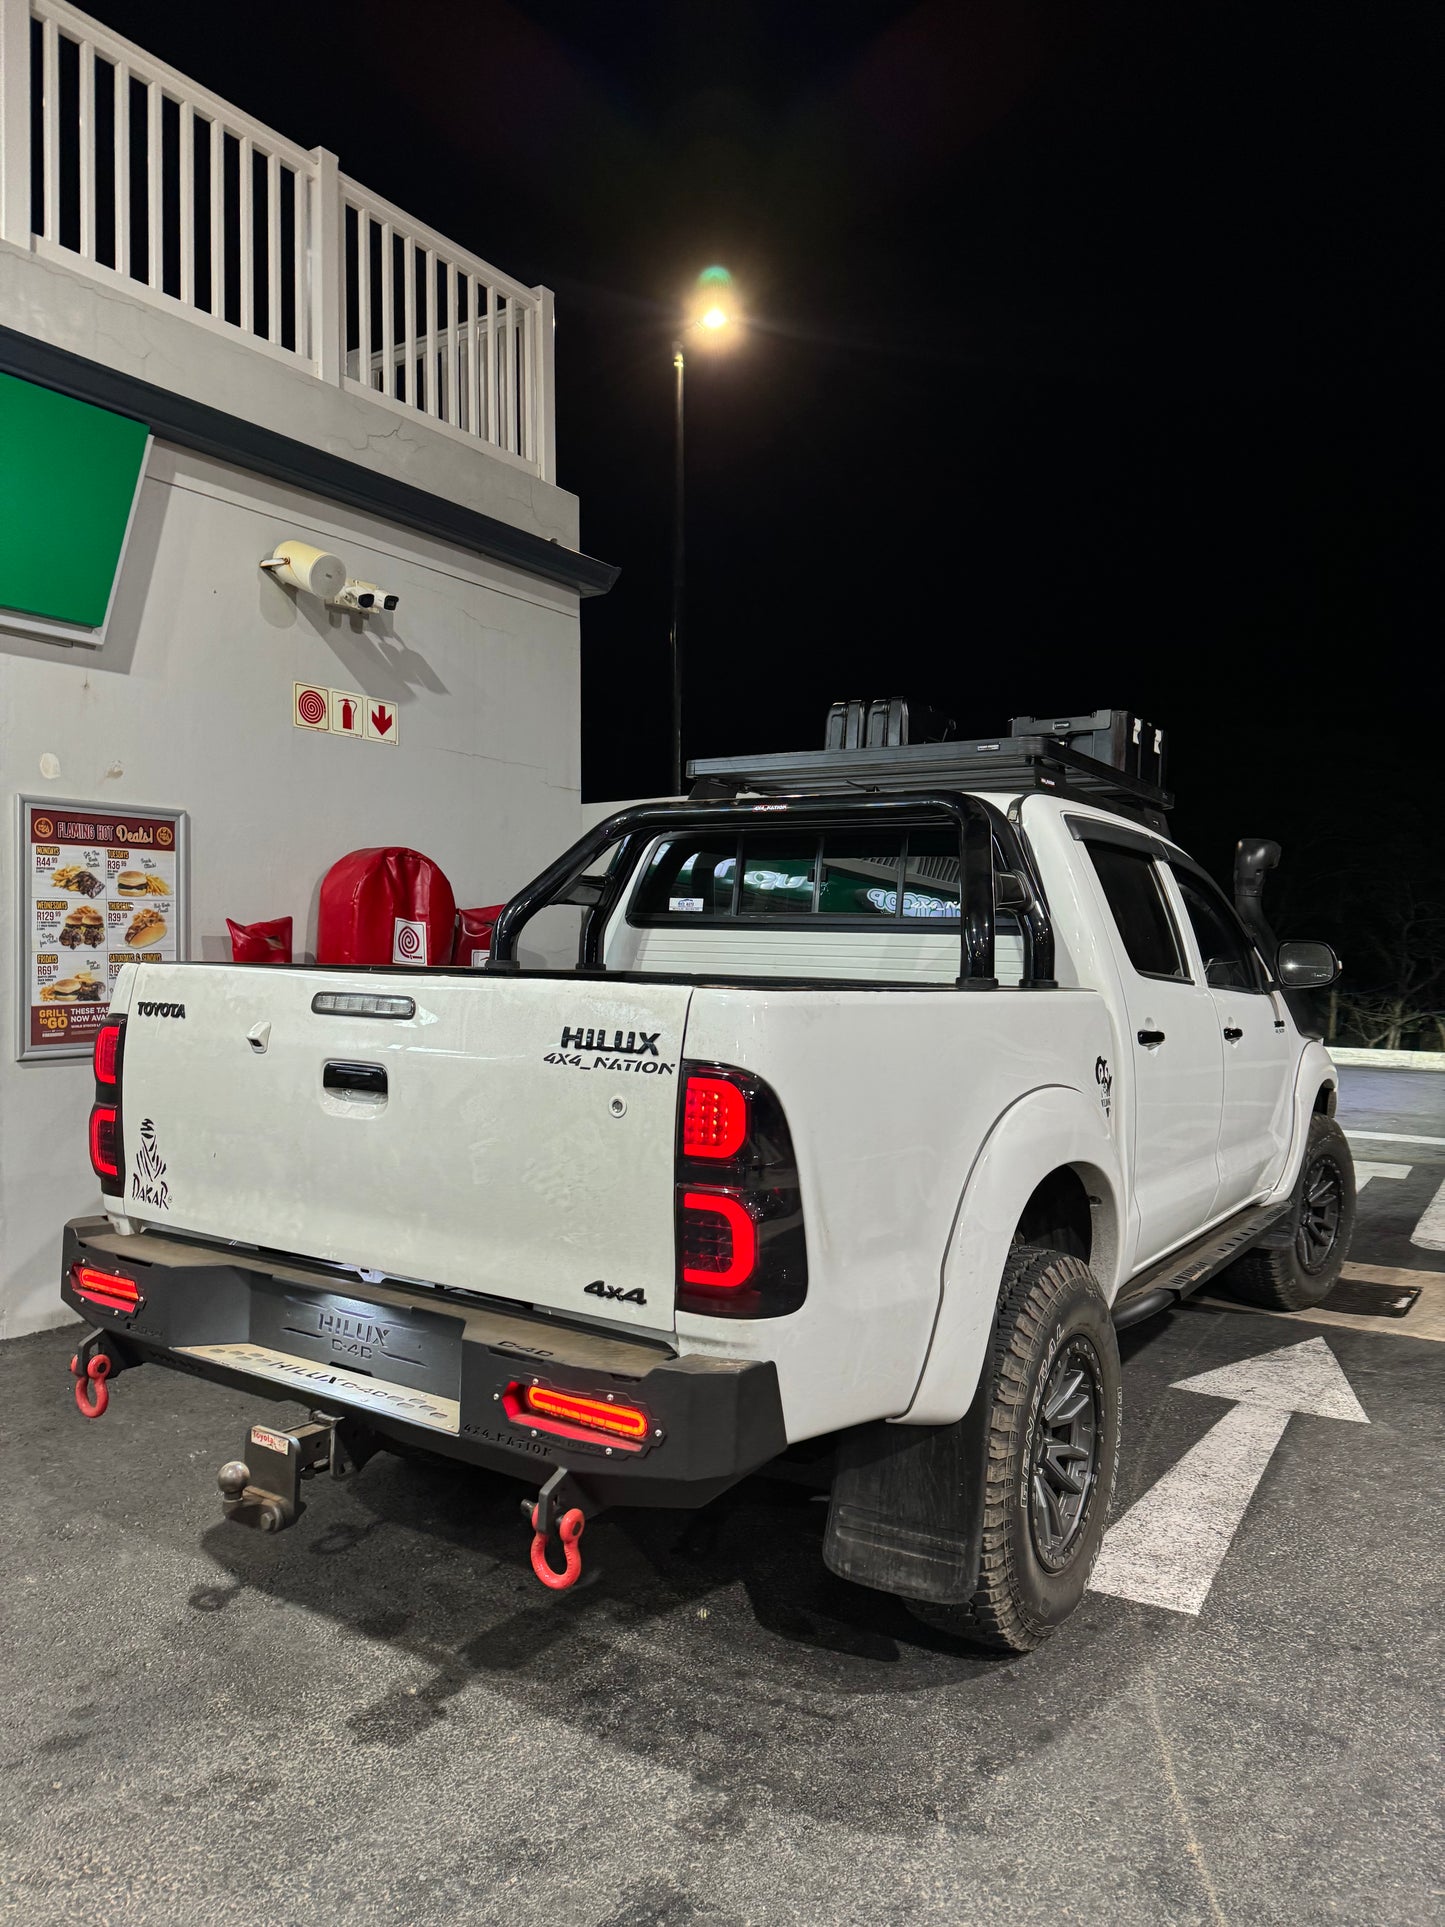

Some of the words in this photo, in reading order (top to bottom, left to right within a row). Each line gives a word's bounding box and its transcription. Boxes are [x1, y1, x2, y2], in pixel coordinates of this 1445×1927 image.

[57, 821, 95, 840] FLAMING
[96, 824, 114, 841] HOT
[115, 824, 153, 844] Deals!
[36, 845, 60, 855] MONDAYS
[107, 849, 129, 860] TUESDAYS
[37, 954, 58, 964] FRIDAYS
[109, 964, 124, 974] R13
[39, 1009, 68, 1018] GRILL
[70, 1007, 95, 1015] THESE
[96, 1006, 110, 1014] TAS
[137, 1001, 186, 1019] TOYOTA
[47, 1016, 68, 1029] GO
[70, 1015, 90, 1023] NOW
[91, 1014, 106, 1022] AVA
[560, 1026, 661, 1056] HILUX
[543, 1052, 676, 1075] 4X4_NATION
[132, 1172, 169, 1210] DAKAR
[317, 1312, 391, 1348] HILUX
[268, 1361, 348, 1384] HILUX
[1020, 1323, 1065, 1508] GENERAL
